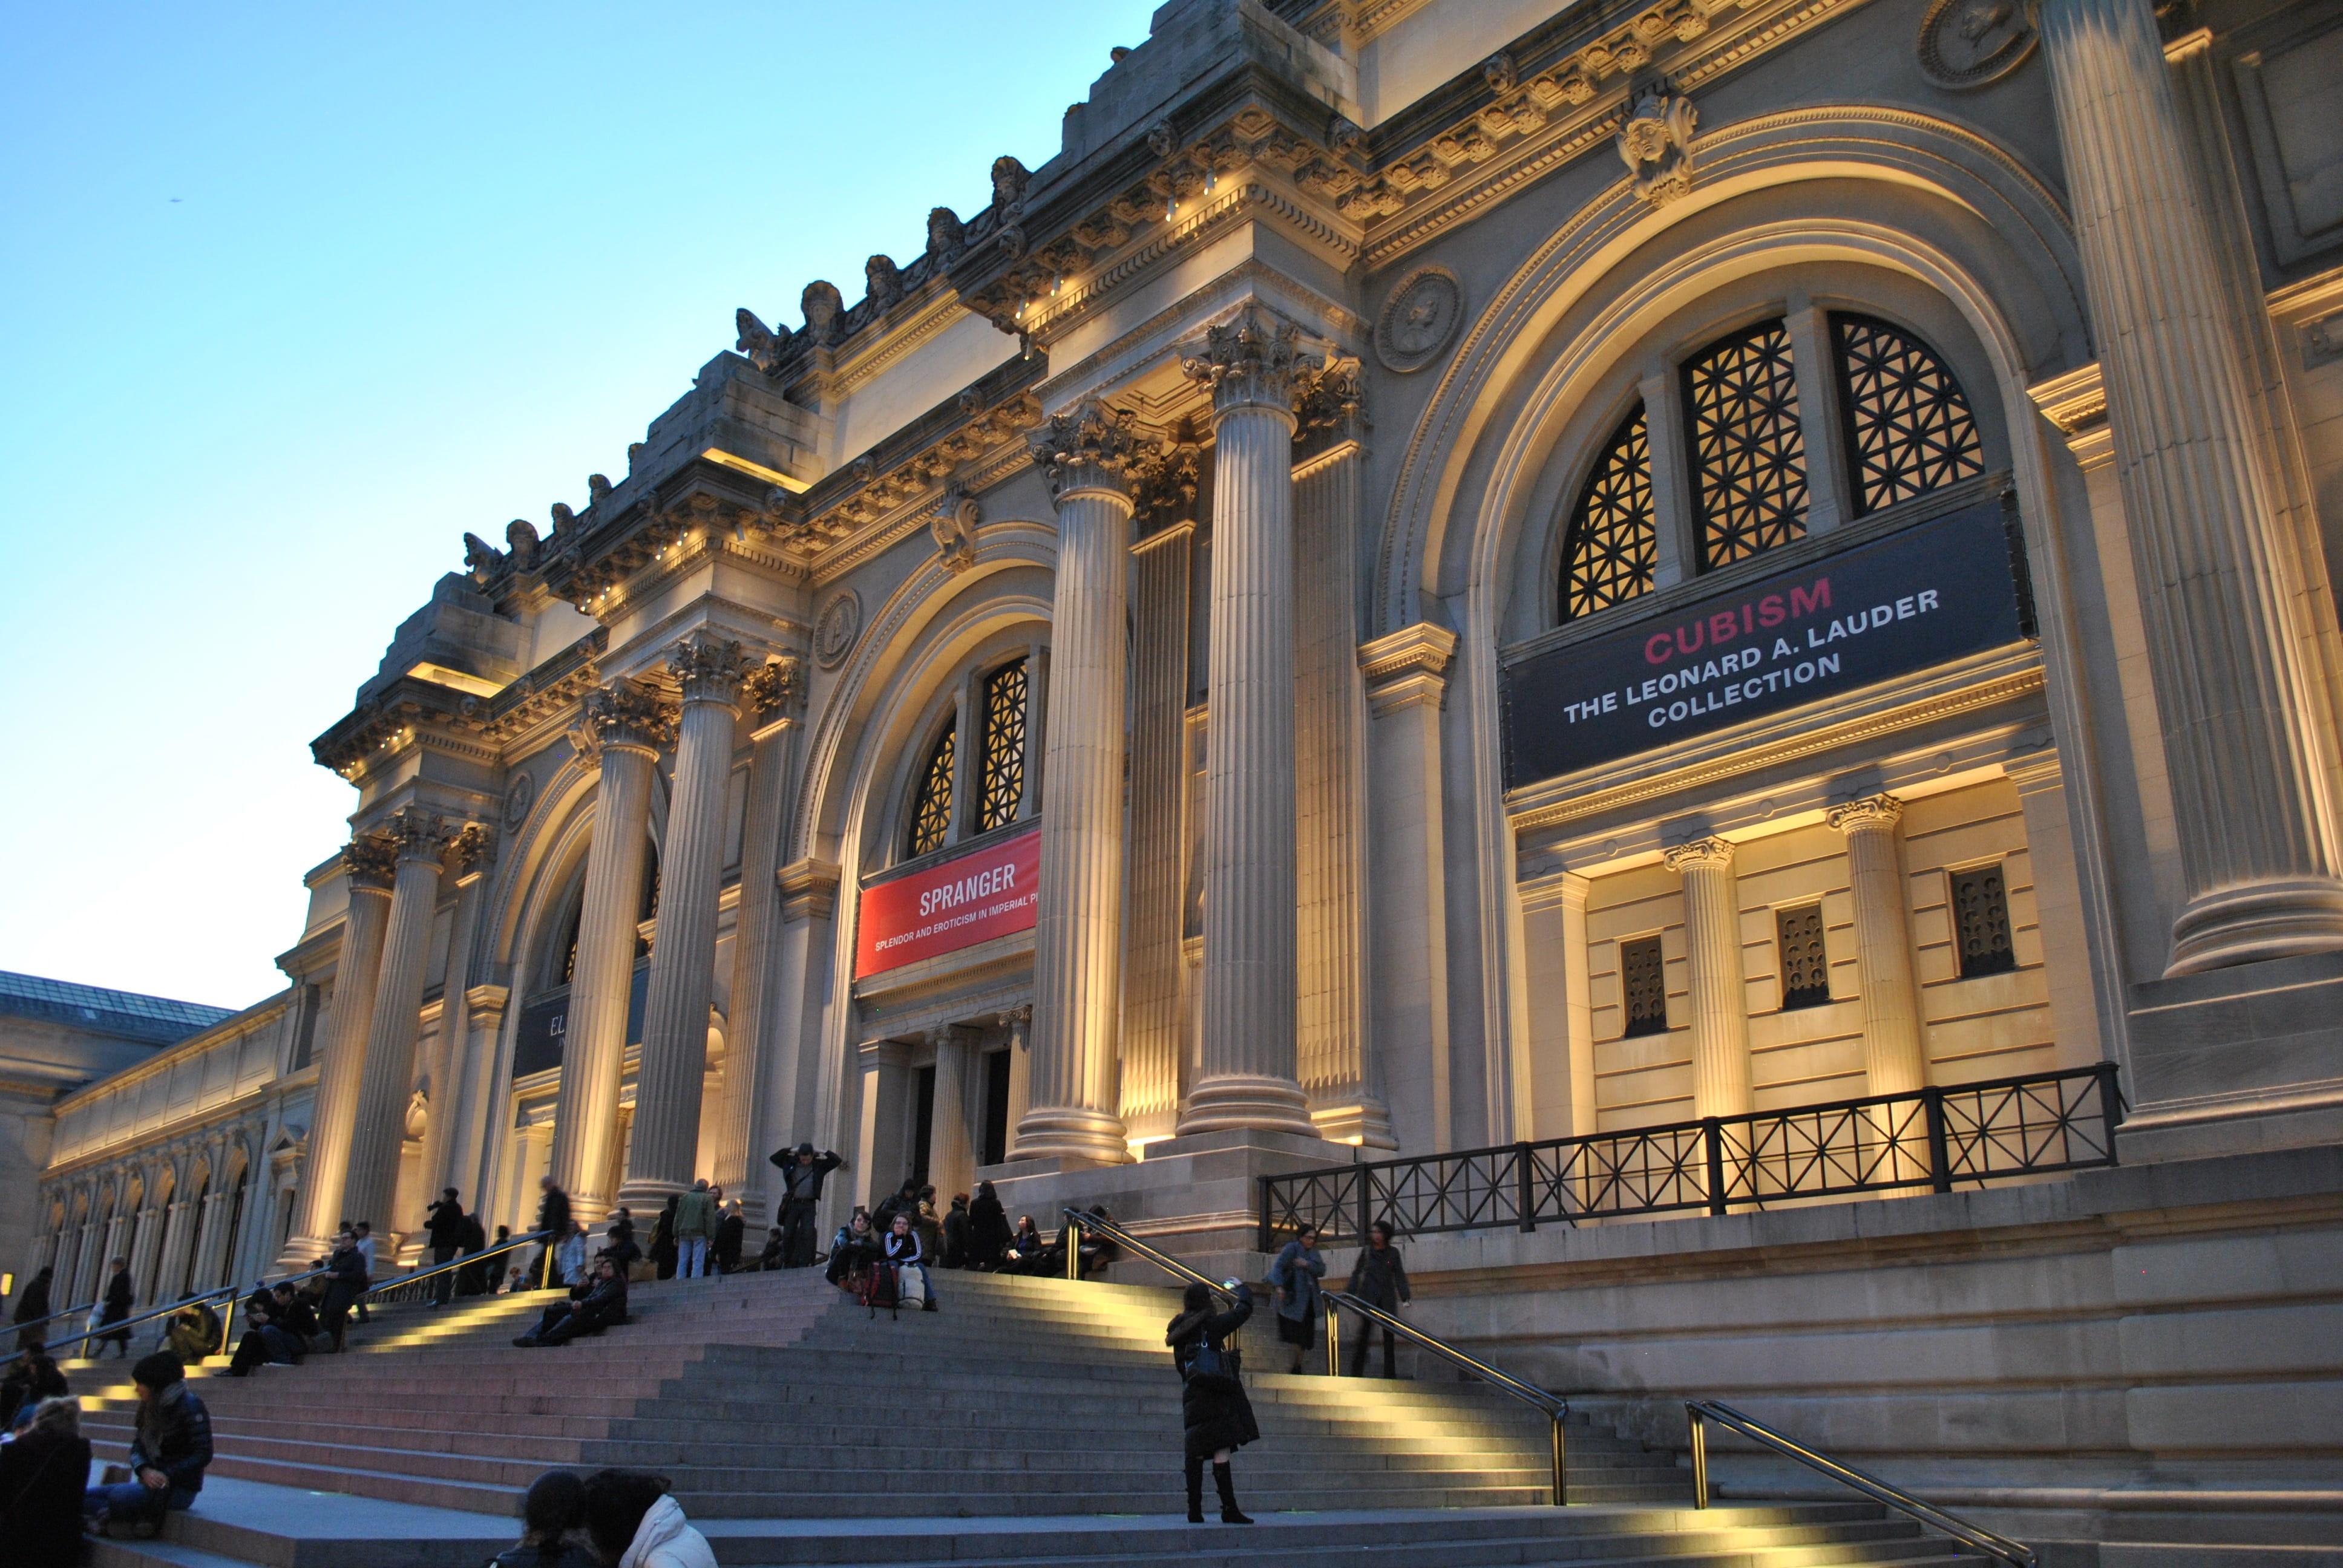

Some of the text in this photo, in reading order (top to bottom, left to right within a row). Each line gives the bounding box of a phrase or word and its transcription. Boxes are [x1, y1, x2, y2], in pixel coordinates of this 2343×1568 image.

[1645, 578, 1831, 664] CUBISM
[1564, 589, 1939, 723] THE LEONARD A. LAUDER
[1648, 653, 1840, 728] COLLECTION
[920, 863, 1015, 916] SPRANGER
[875, 932, 914, 952] SPLENDOR
[916, 926, 932, 938] AND
[934, 913, 977, 933] EROTICISM
[978, 908, 987, 920] IN
[989, 896, 1028, 916] IMPERIAL
[550, 1015, 565, 1036] EL
